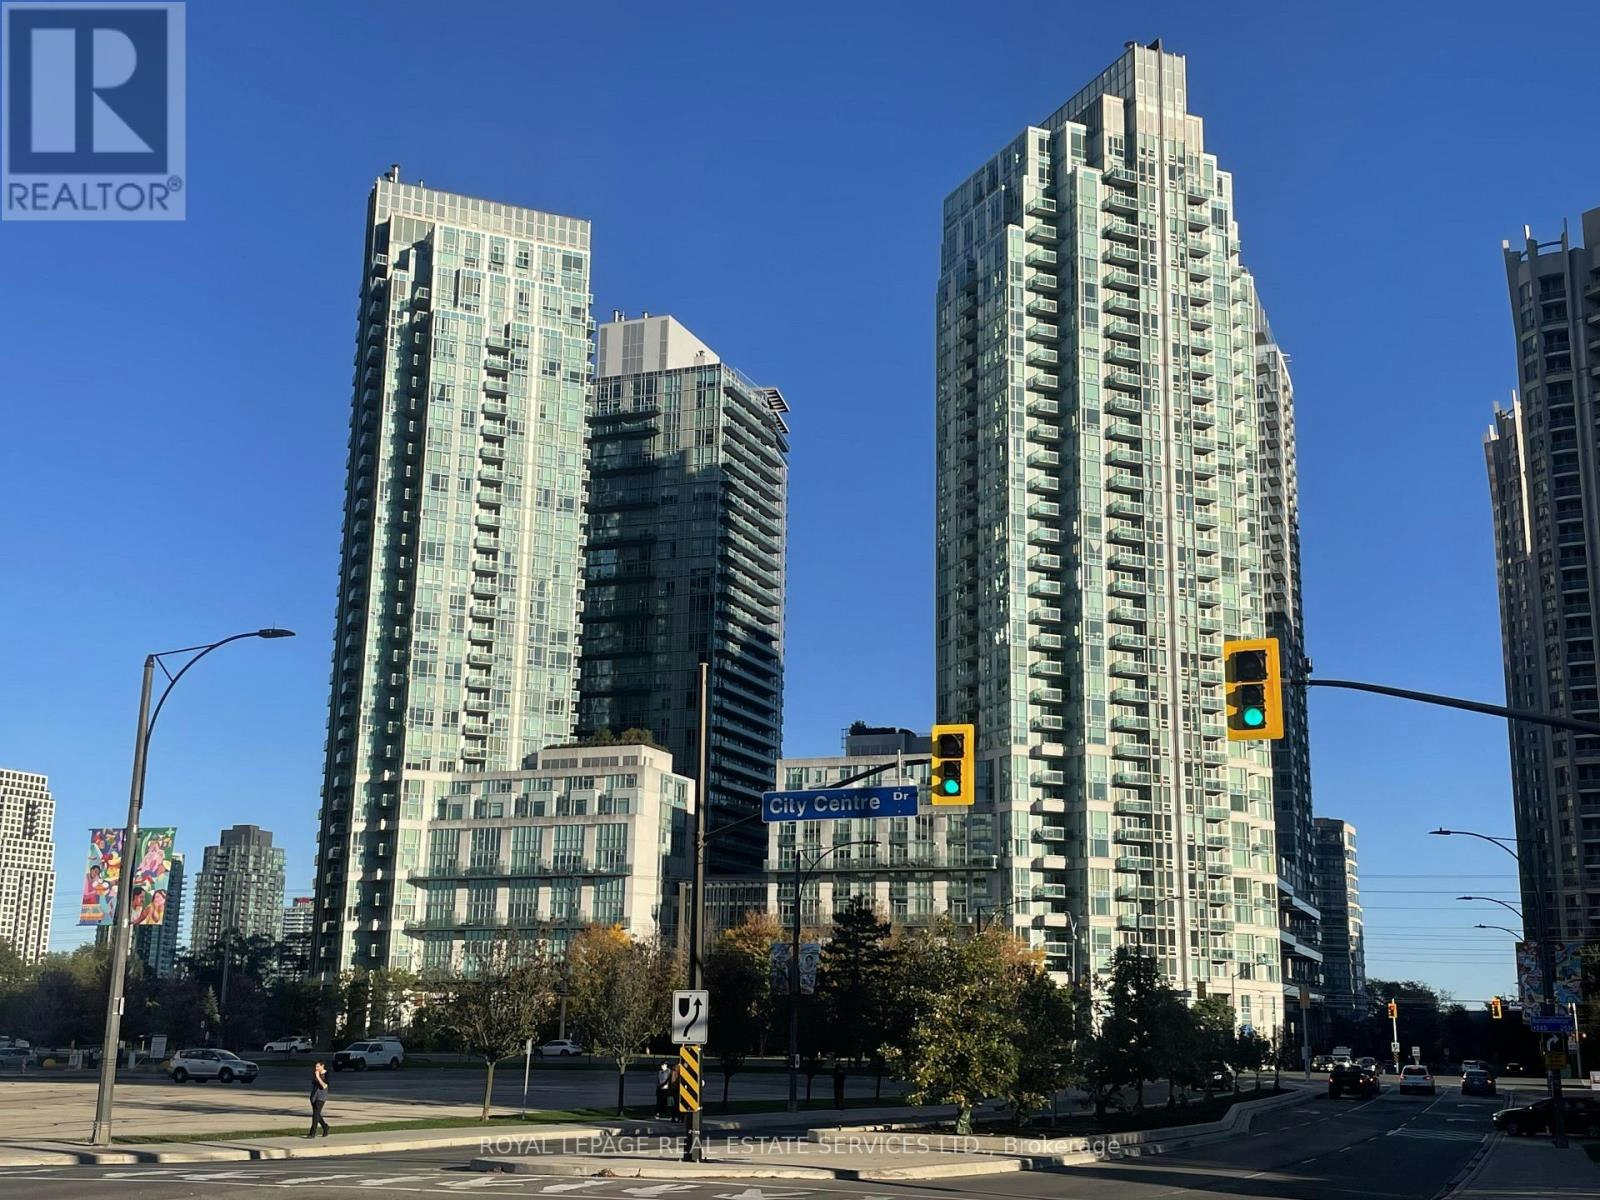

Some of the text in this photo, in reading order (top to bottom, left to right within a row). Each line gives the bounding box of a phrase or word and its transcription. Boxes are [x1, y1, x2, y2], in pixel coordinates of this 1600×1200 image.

[769, 791, 910, 817] City Centre Dr
